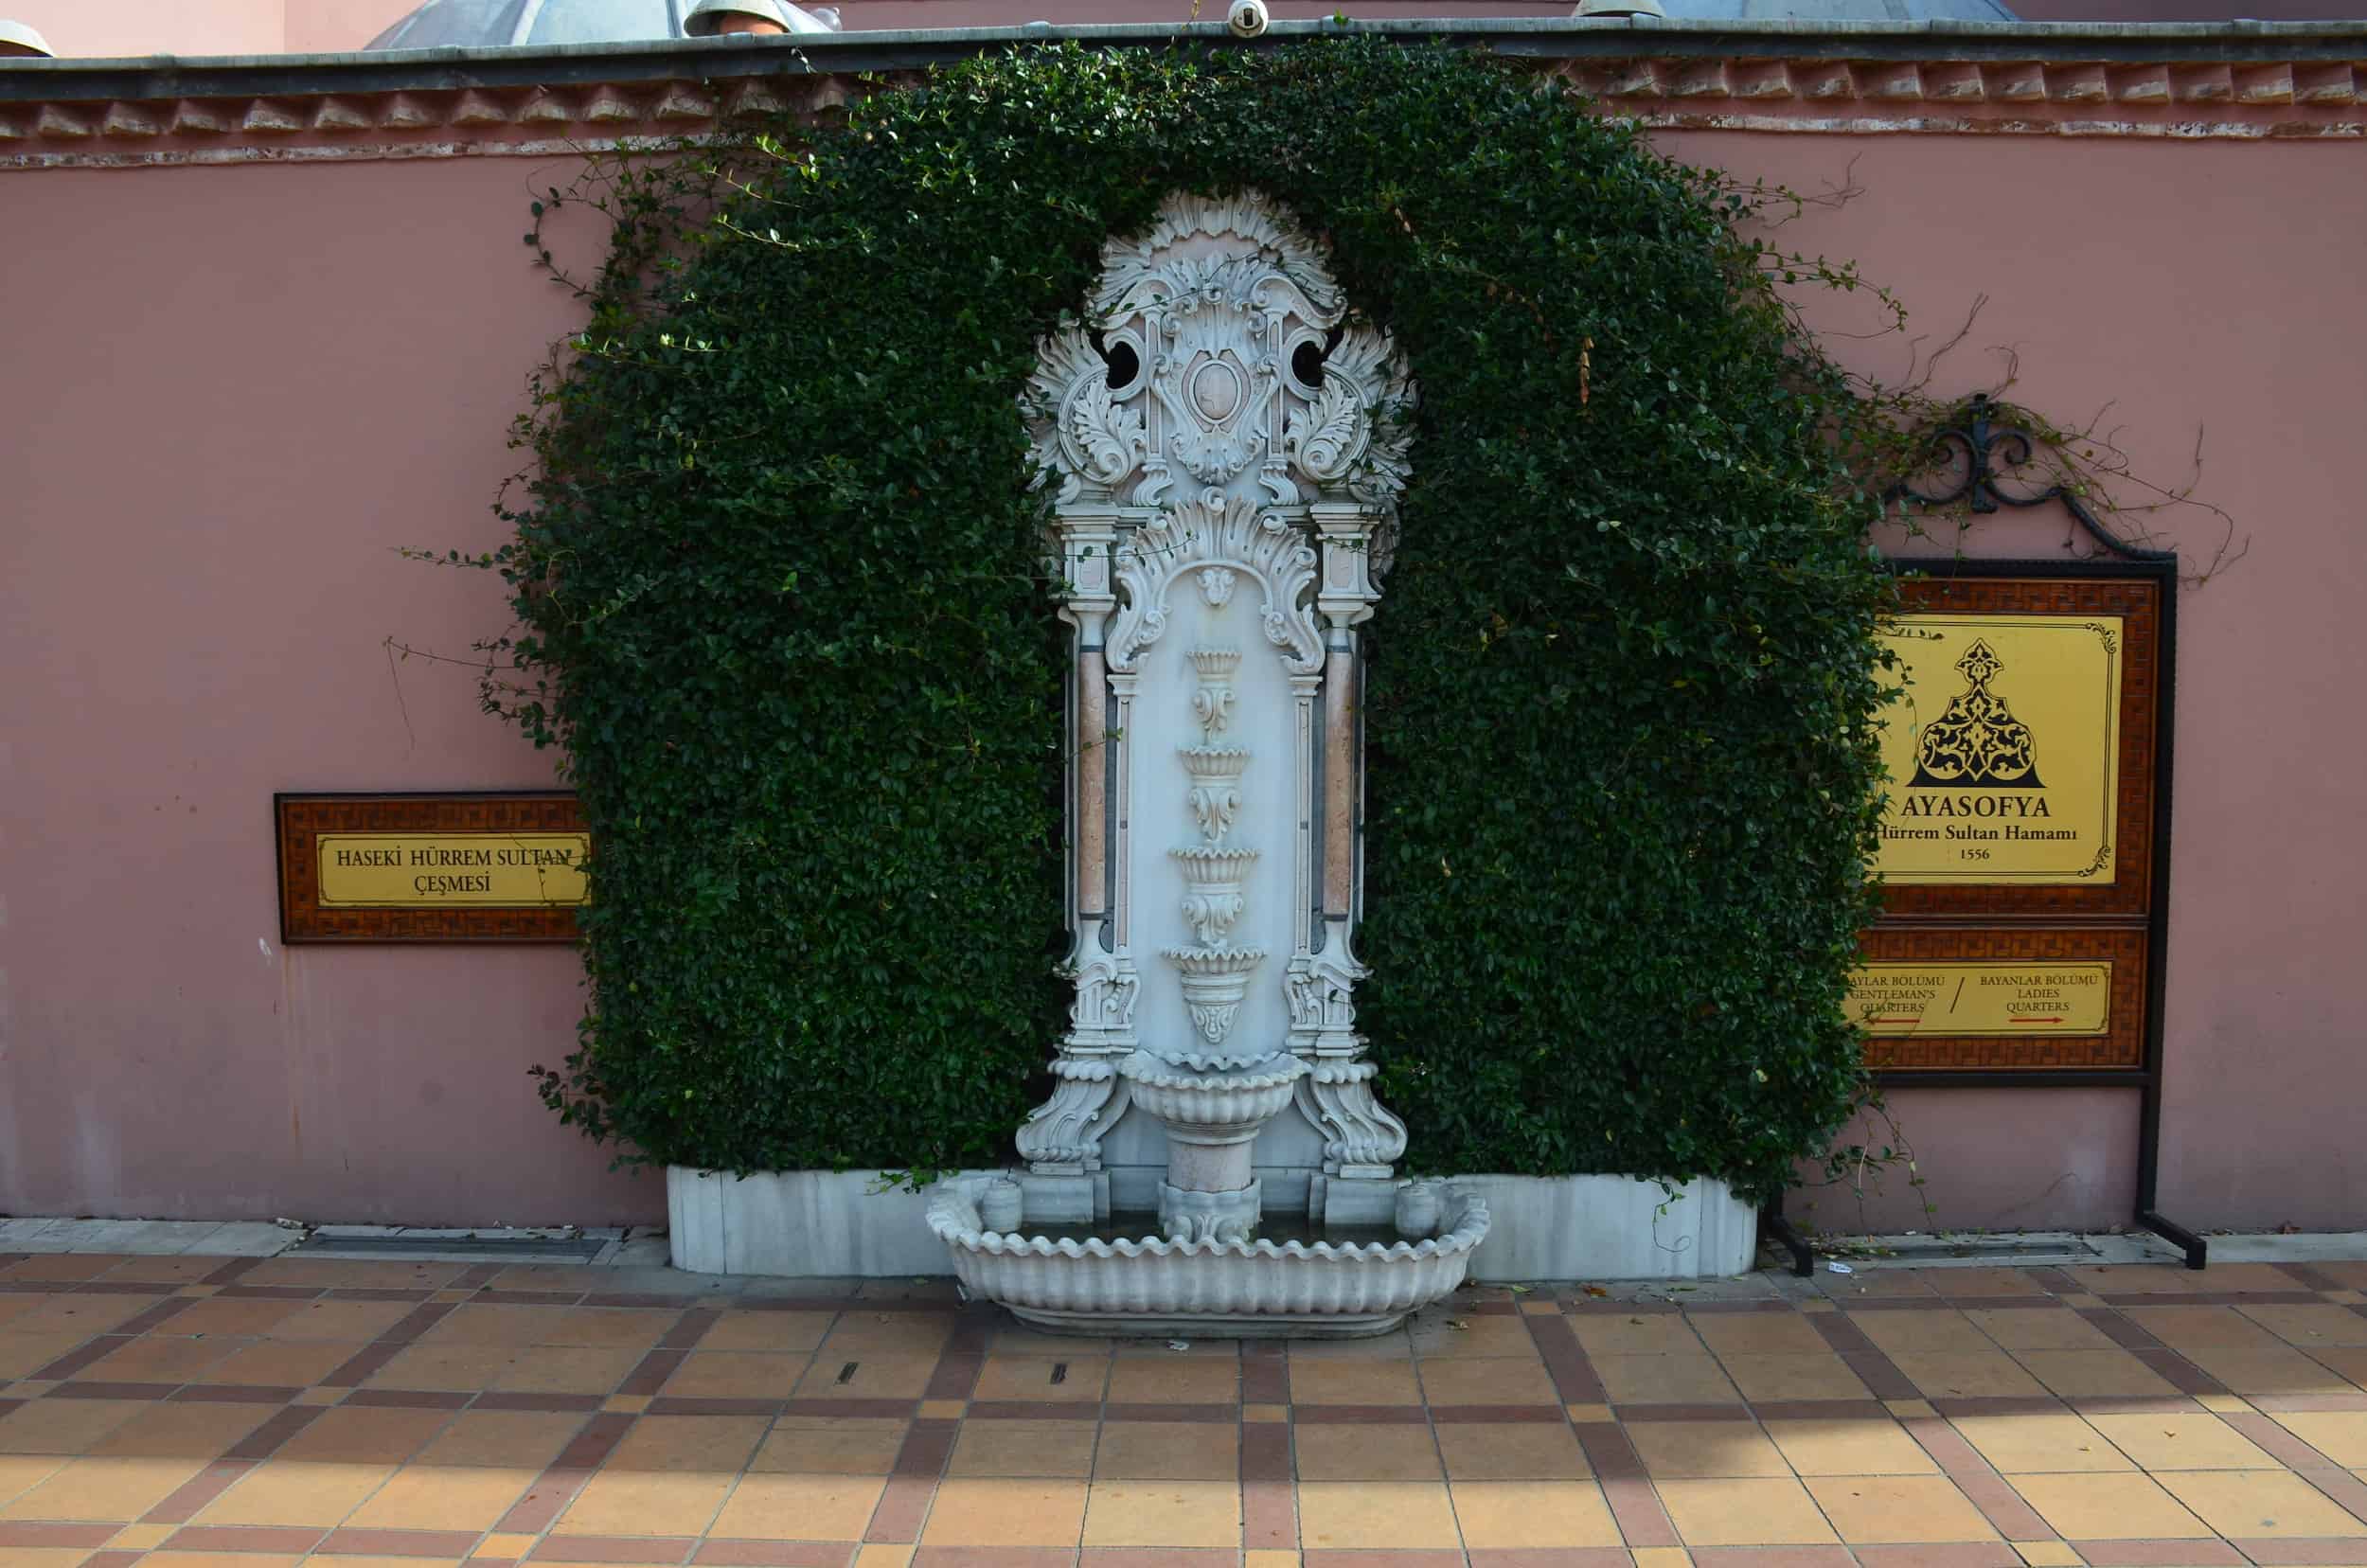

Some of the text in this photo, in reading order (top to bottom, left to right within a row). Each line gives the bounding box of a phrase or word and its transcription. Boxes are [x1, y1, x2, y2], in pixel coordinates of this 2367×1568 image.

[1901, 795, 2051, 817] AYASOFYA
[1945, 825, 1999, 840] Sultan
[2004, 825, 2076, 840] Hamamı
[337, 846, 571, 866] HASEKİ HÜRREM SULTAN
[1961, 848, 1990, 860] 1556
[414, 870, 491, 896] ÇEŞMESİ
[1847, 976, 1887, 986] AYLAR
[1980, 975, 2042, 986] BAYANLAR
[1849, 989, 1935, 1000] GENTLEMAN'S
[2017, 989, 2060, 999] LADIES
[1860, 1003, 1925, 1013] QUARTERS
[2006, 1002, 2070, 1013] QUARTERS
